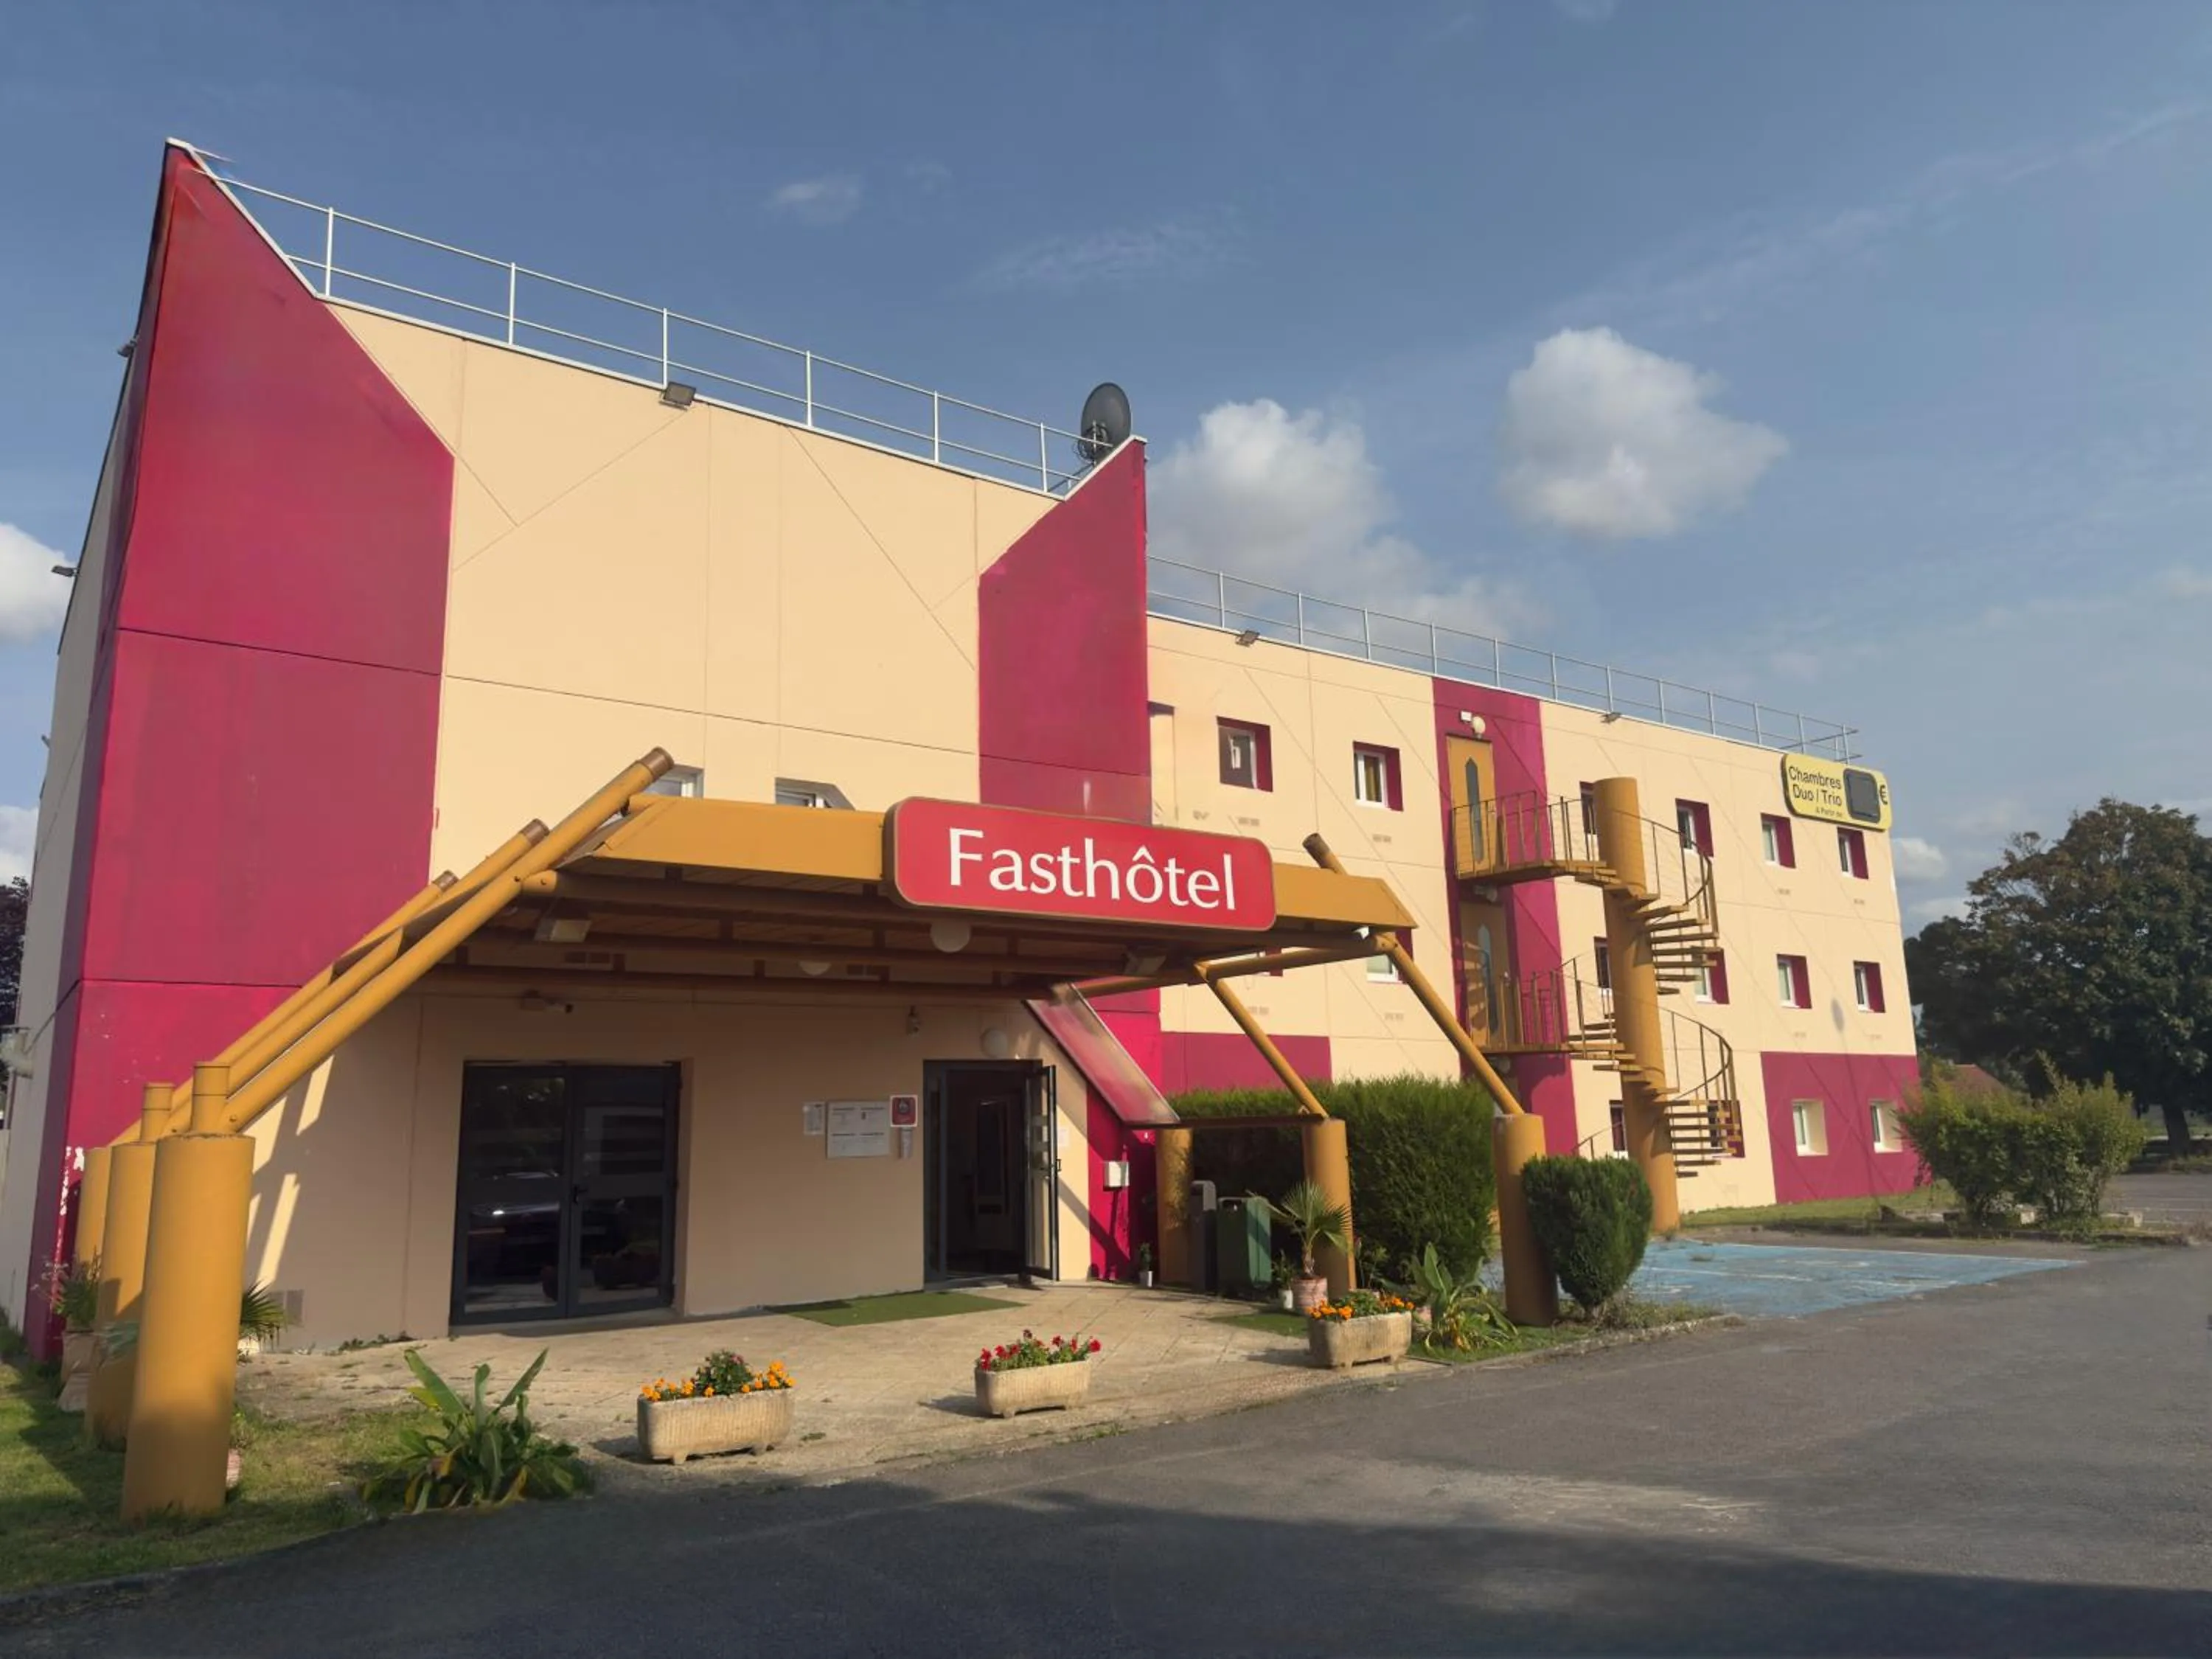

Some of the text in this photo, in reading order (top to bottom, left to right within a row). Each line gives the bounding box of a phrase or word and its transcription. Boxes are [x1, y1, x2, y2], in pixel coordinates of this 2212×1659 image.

[1788, 766, 1842, 790] Chambres
[1792, 784, 1815, 801] Duo
[1821, 790, 1842, 807] Trio
[1879, 785, 1888, 805] €
[948, 827, 1237, 911] Fasthôtel
